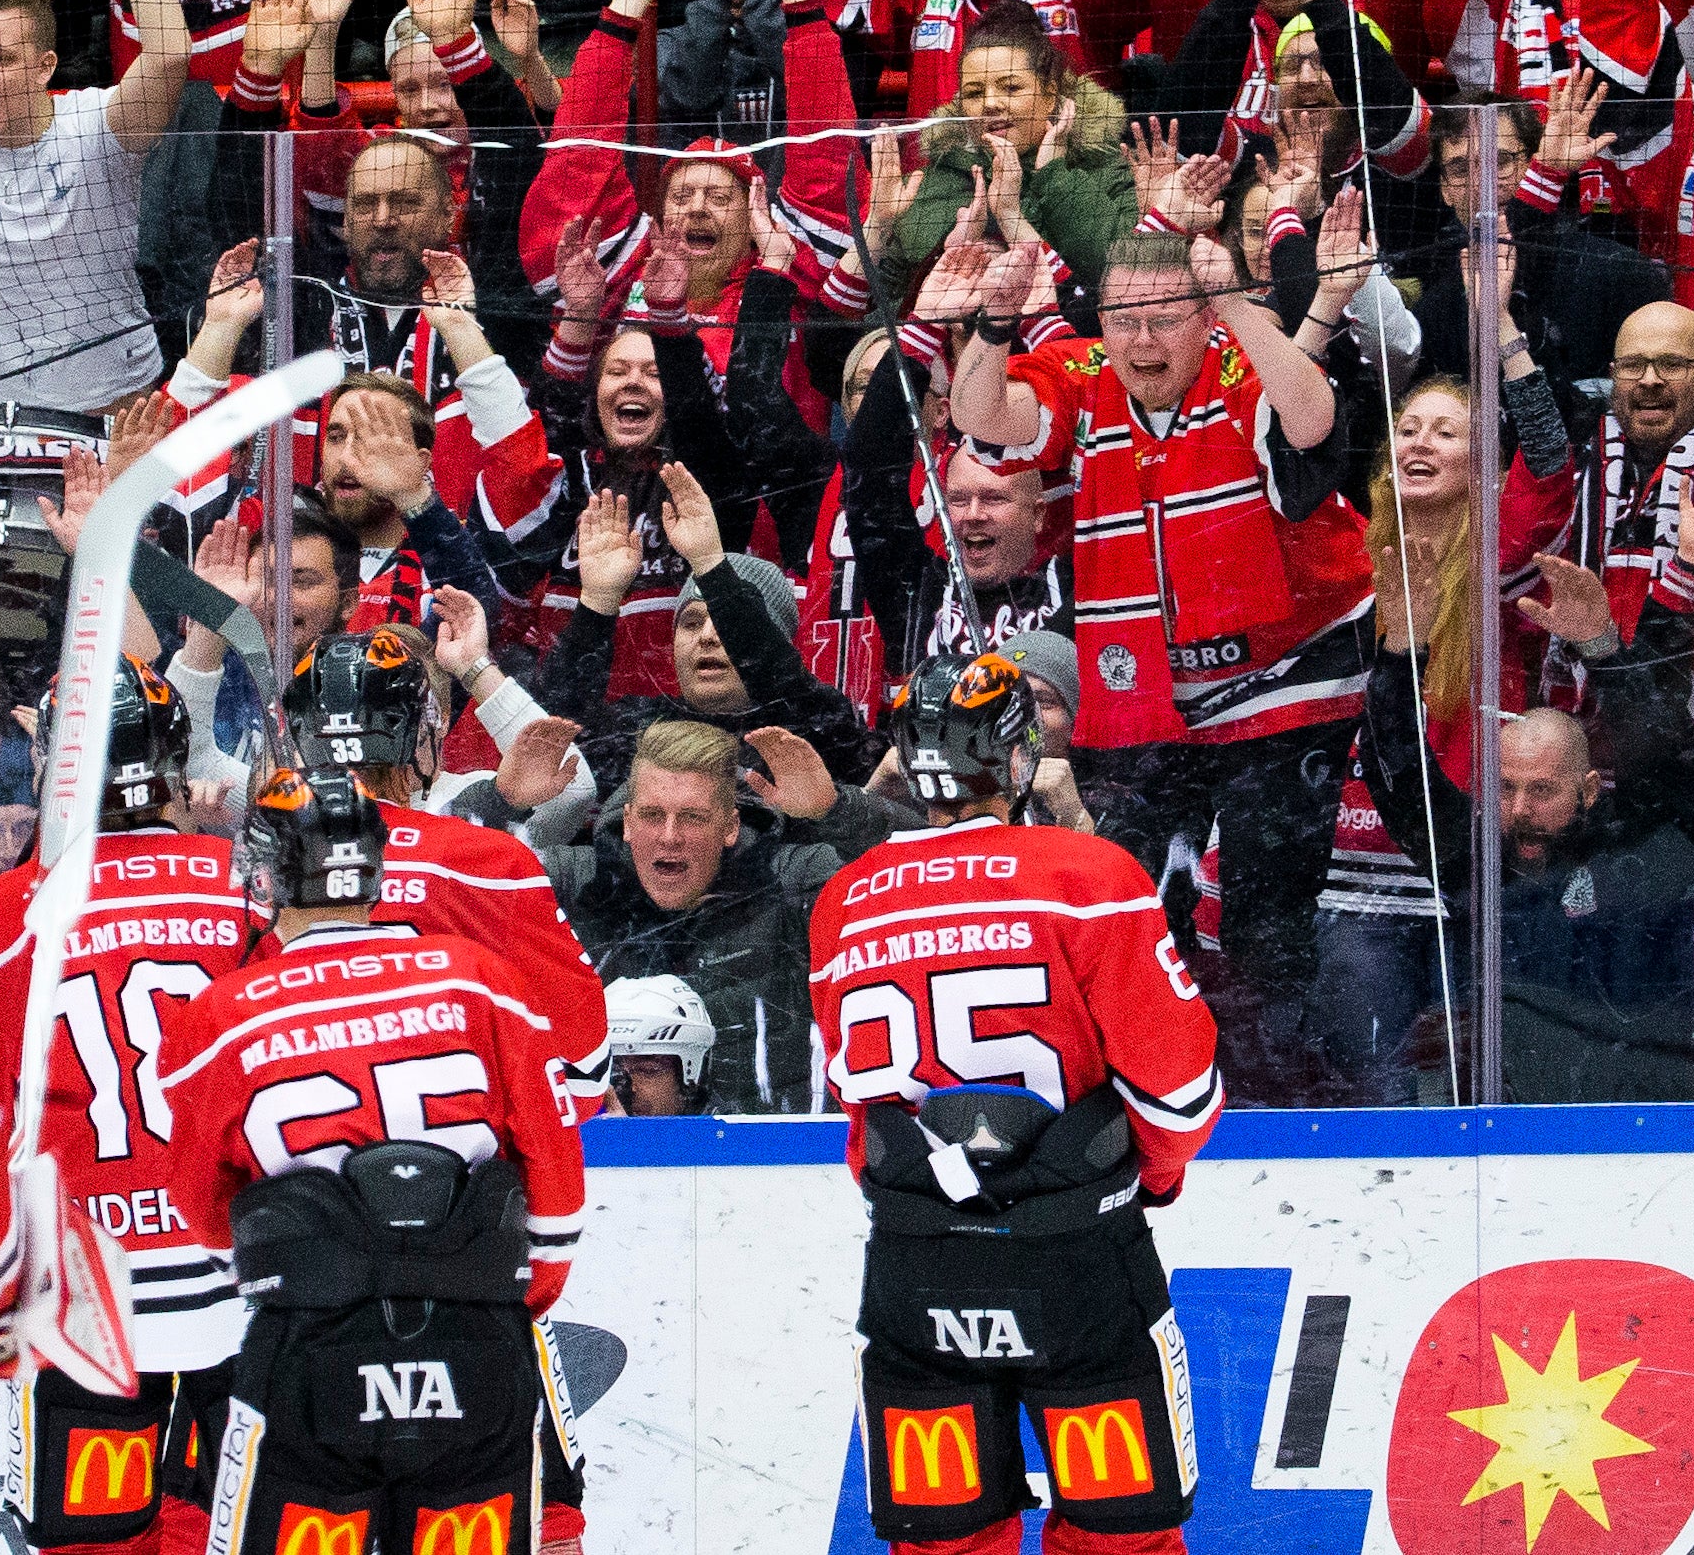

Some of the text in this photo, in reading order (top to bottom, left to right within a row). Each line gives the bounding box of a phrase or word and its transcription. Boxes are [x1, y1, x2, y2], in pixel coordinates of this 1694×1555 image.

[330, 737, 365, 765] 33
[121, 784, 150, 809] 18
[916, 773, 958, 799] 85
[326, 869, 360, 899] 65
[843, 855, 1018, 905] CONSTO
[238, 947, 451, 999] CONSTO
[831, 921, 1033, 983] MALMBERGS
[240, 999, 466, 1074] MALMBERGS
[826, 965, 1066, 1115] 85
[242, 1050, 499, 1178] 65
[927, 1308, 1034, 1358] NA
[357, 1361, 464, 1424] NA
